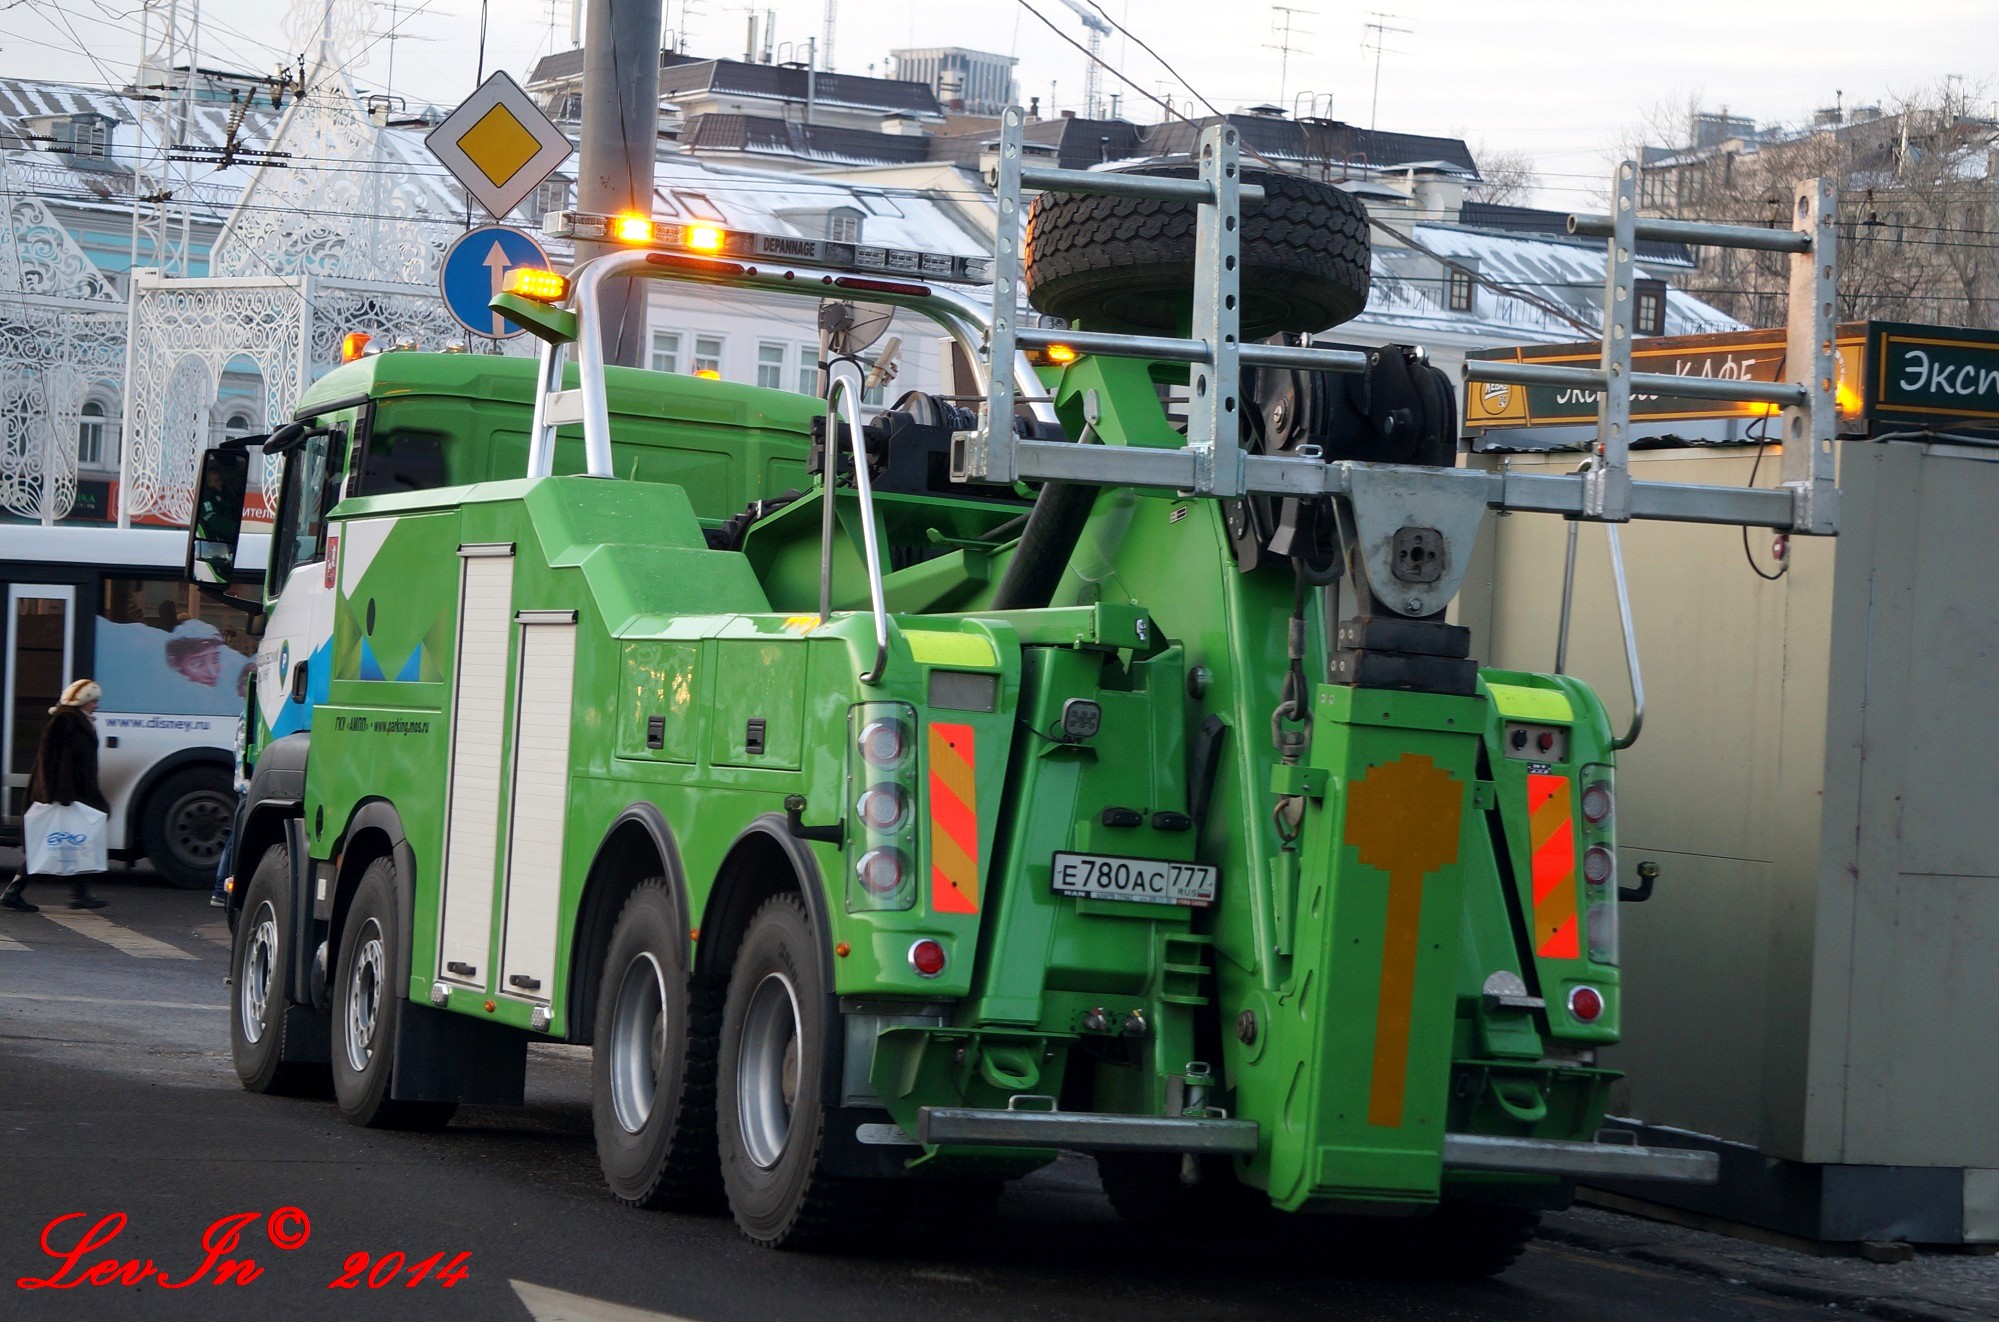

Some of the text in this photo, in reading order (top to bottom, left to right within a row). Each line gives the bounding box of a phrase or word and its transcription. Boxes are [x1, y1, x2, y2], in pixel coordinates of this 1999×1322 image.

[763, 237, 816, 258] DEPANNAGE
[105, 717, 211, 731] www.disney.ru
[374, 718, 430, 736] www.parking.mos.ru
[1170, 866, 1208, 889] 777
[1177, 888, 1197, 897] RUS
